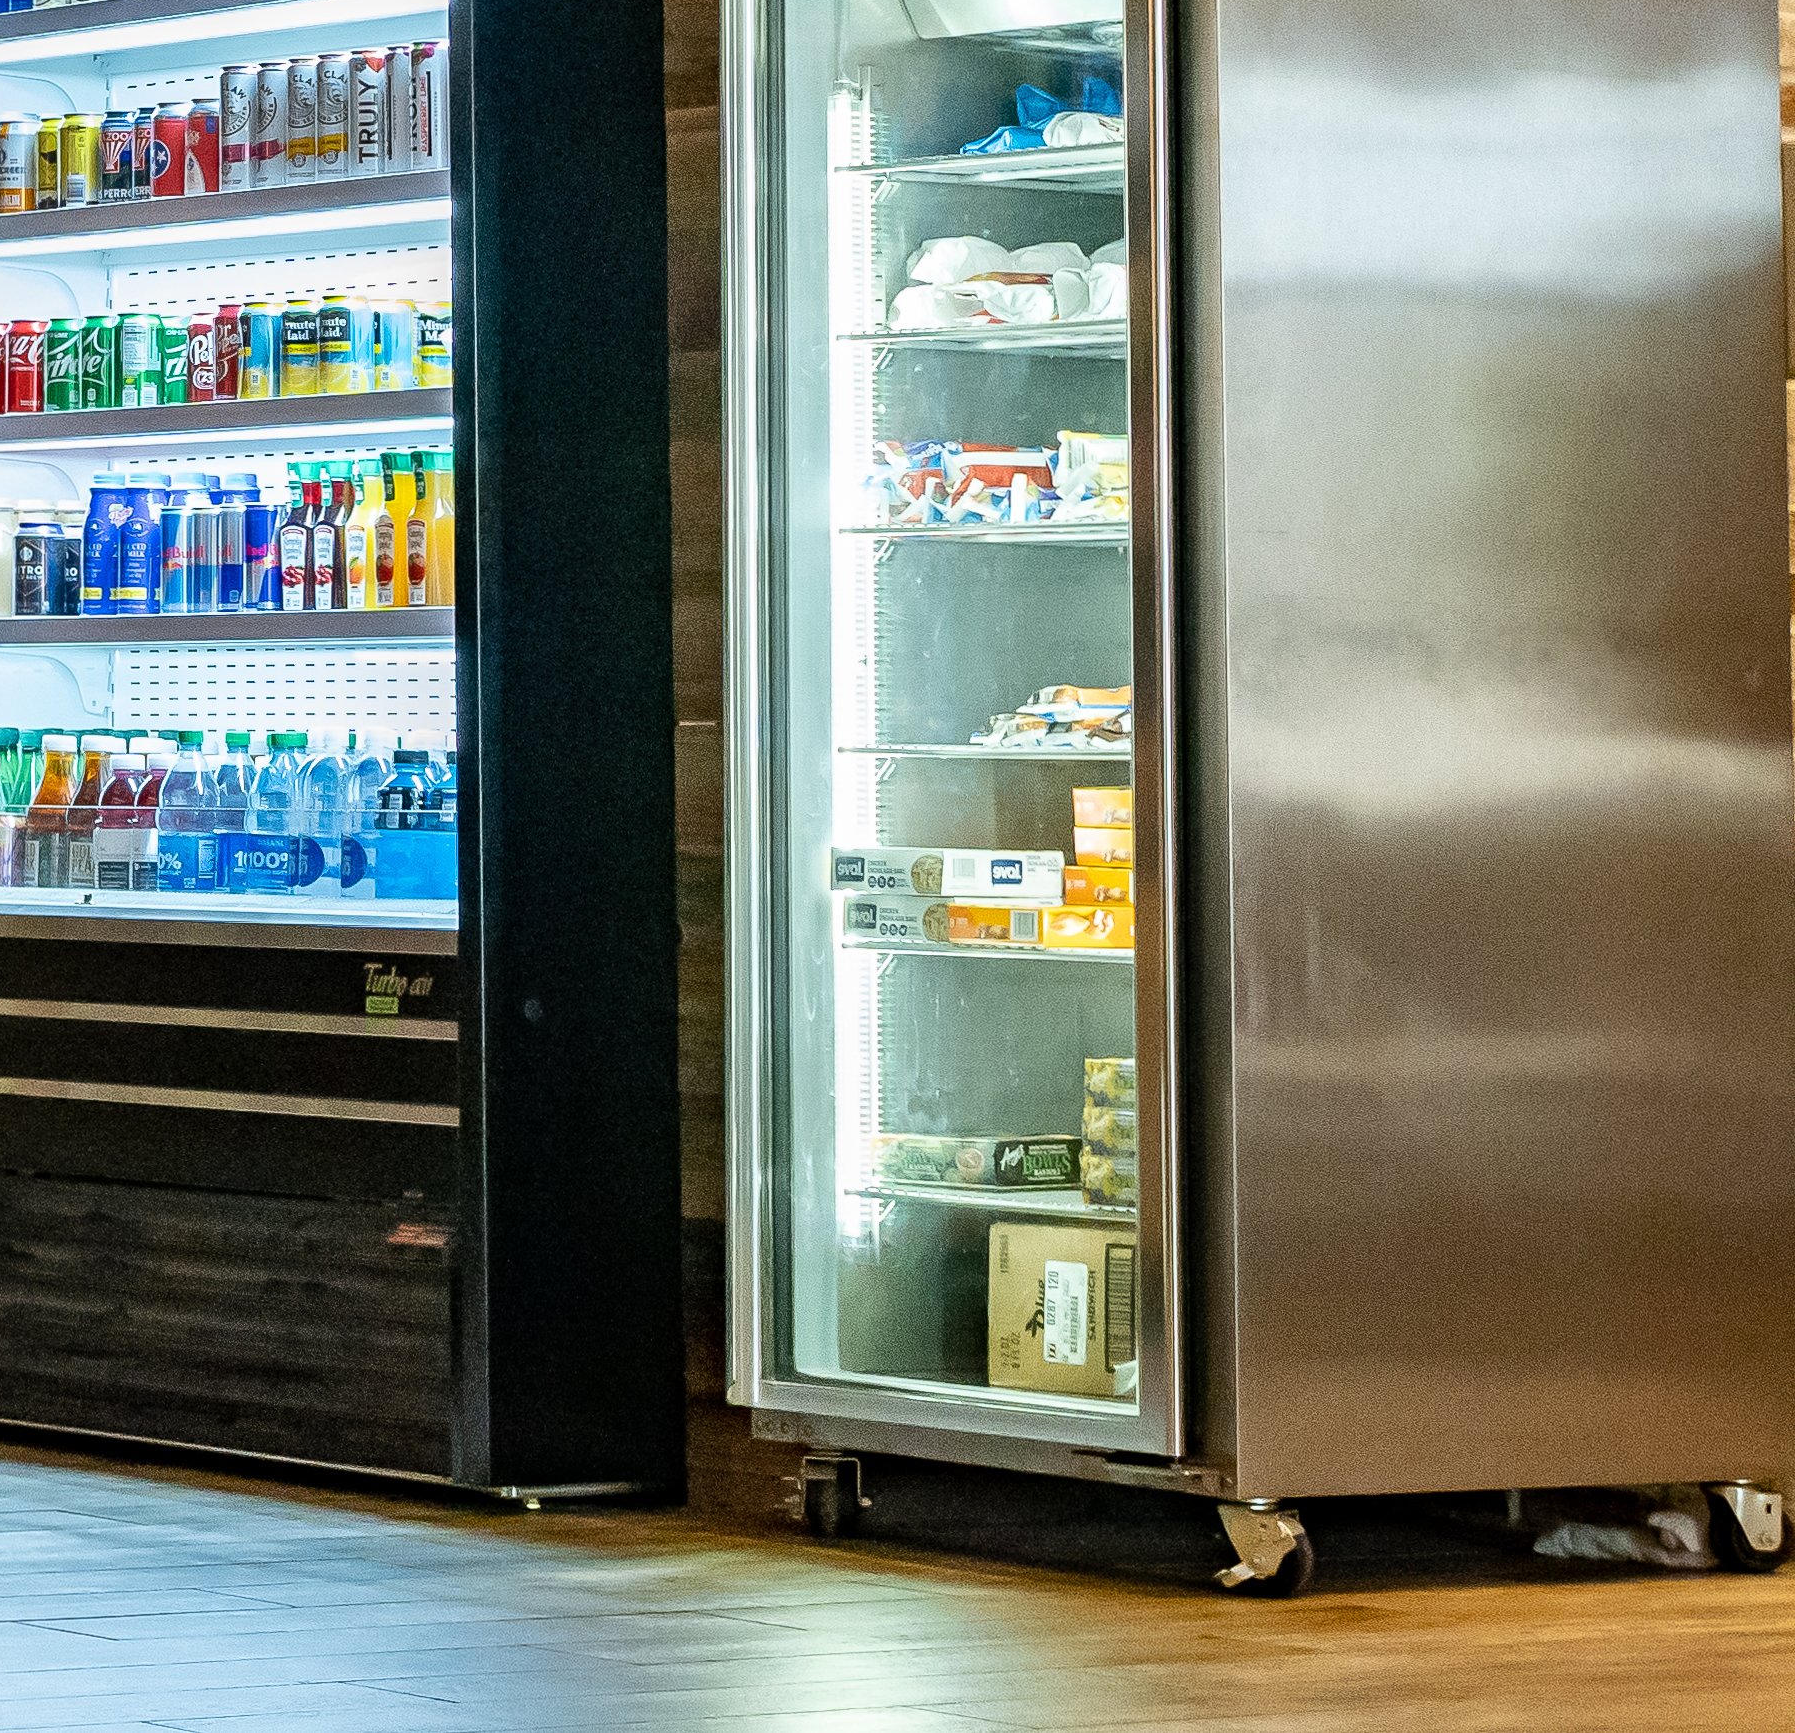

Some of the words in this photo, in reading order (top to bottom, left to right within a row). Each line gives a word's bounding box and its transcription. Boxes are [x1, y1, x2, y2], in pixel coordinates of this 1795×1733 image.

[293, 75, 312, 85] CLA
[358, 79, 378, 163] TRULY
[364, 963, 406, 997] Turbo
[411, 974, 434, 997] air
[1048, 1271, 1059, 1289] 120
[1088, 1270, 1096, 1340] SANDWICH
